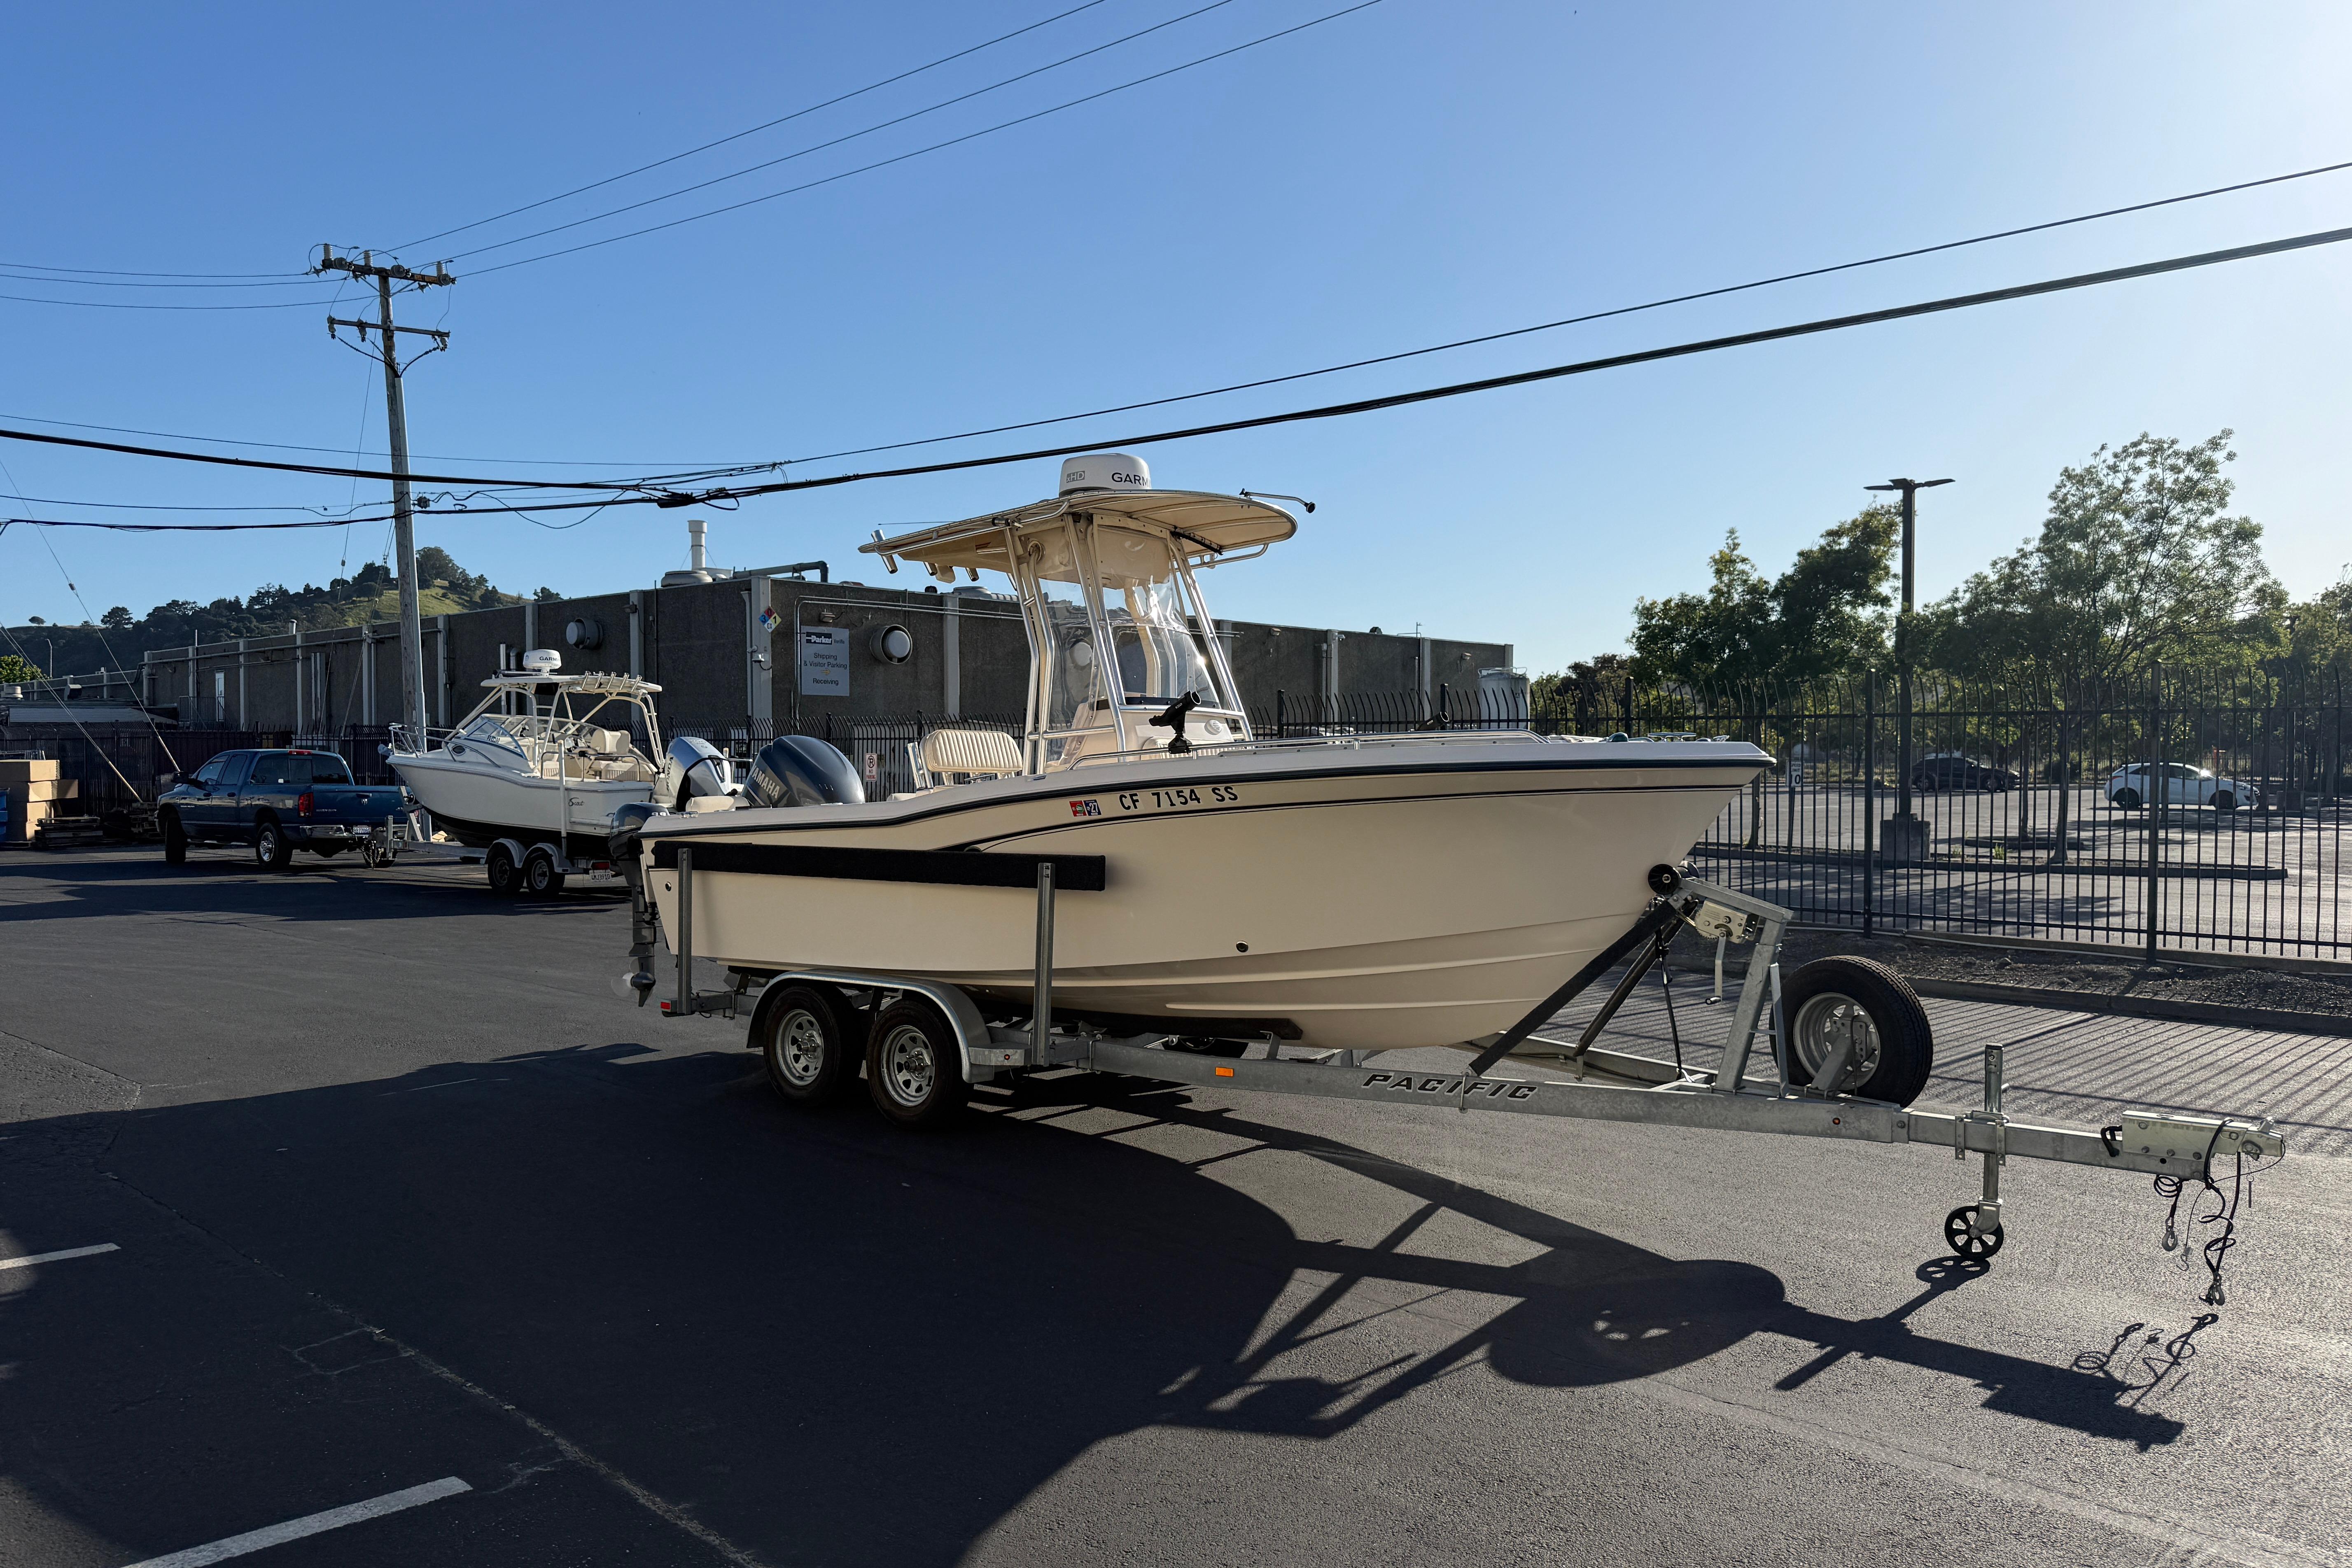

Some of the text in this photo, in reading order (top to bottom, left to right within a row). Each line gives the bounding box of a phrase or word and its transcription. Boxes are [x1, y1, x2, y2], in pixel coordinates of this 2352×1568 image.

[1067, 471, 1084, 482] xHD
[773, 616, 777, 624] 1
[811, 635, 832, 644] Parker
[814, 653, 837, 661] Shipping
[1119, 786, 1238, 810] CF 7154 SS
[1089, 803, 1098, 812] 27
[1361, 1073, 1538, 1101] PACIFIC
